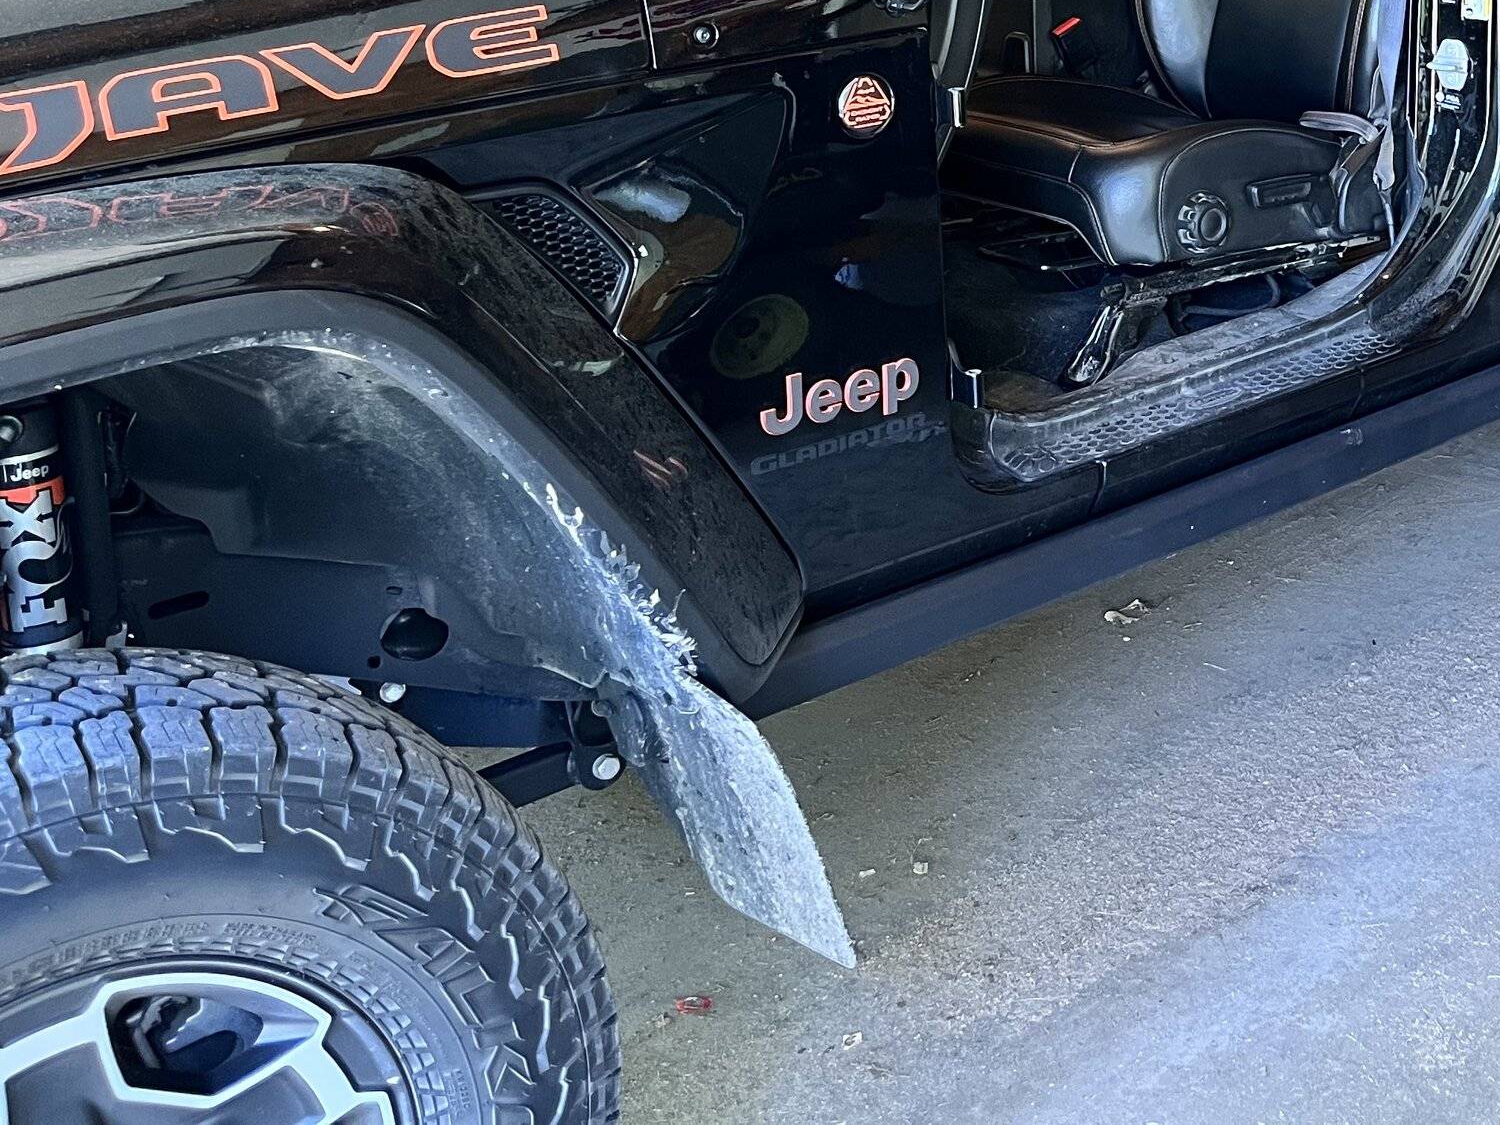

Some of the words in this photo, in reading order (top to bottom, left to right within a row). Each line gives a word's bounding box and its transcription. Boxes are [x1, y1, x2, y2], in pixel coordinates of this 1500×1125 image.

[760, 357, 920, 436] Jeep
[10, 463, 49, 482] Jeep
[750, 411, 927, 475] GLADIATOR
[0, 489, 70, 633] FOX
